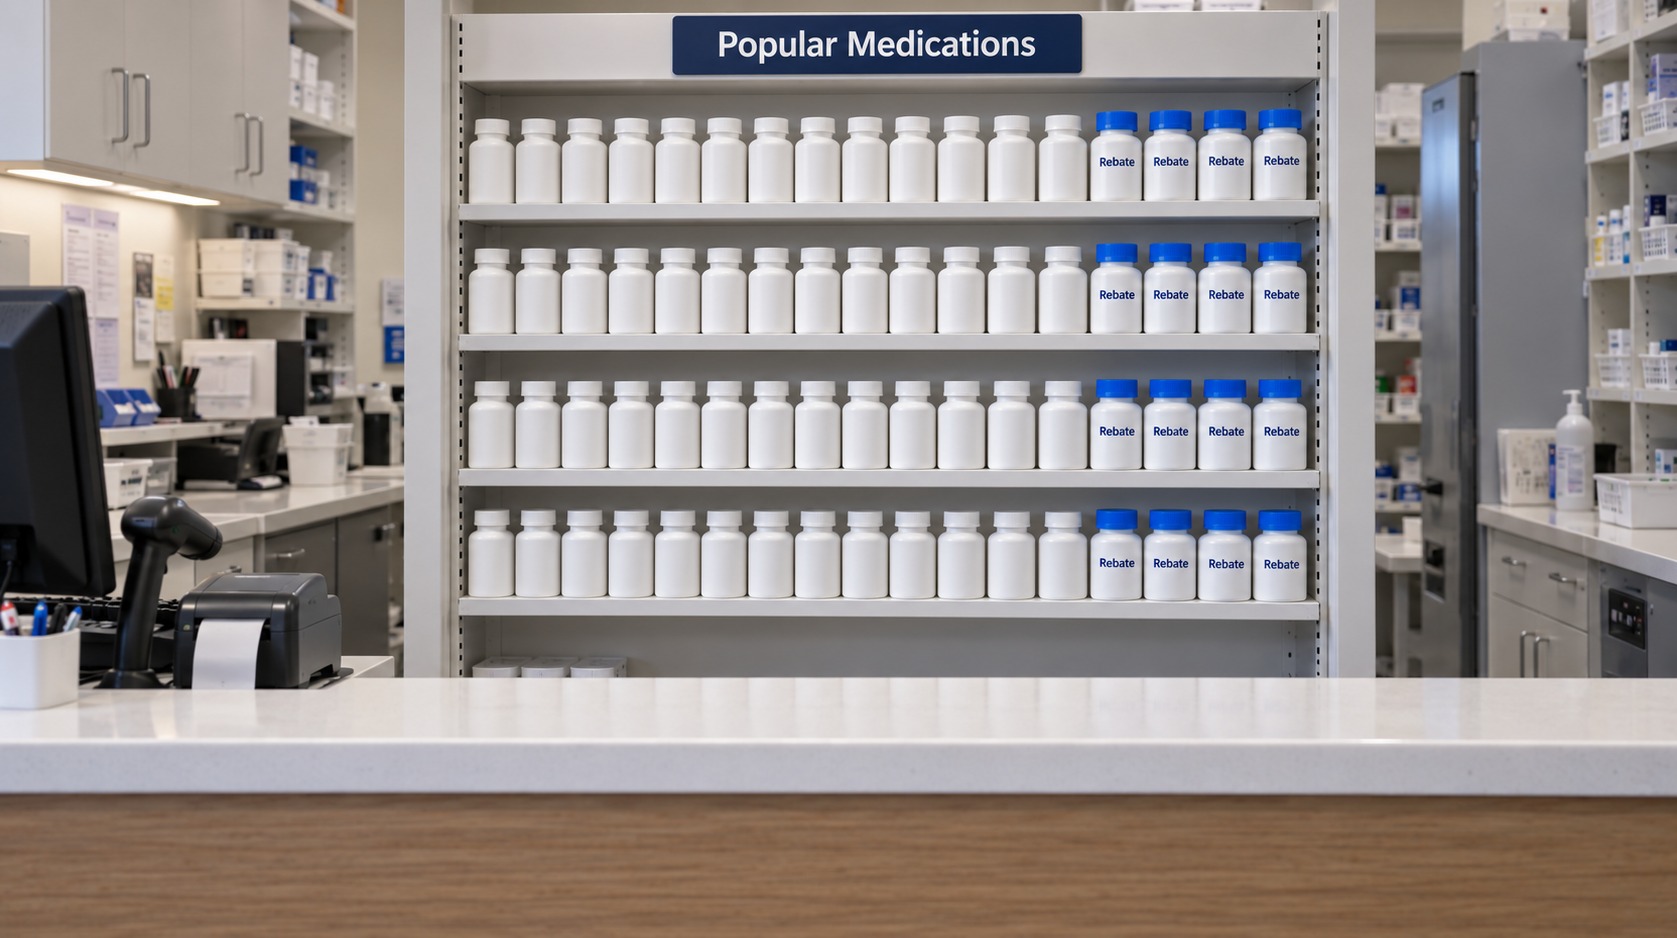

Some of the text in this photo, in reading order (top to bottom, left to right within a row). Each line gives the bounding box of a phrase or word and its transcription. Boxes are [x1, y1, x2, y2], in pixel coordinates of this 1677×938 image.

[718, 30, 1036, 64] Popular Medications
[1099, 156, 1136, 168] Rebate
[1153, 156, 1190, 167] Rebate
[1208, 155, 1245, 167] Rebate
[1263, 154, 1301, 166] Rebate
[1099, 289, 1136, 300] Rebate
[1153, 289, 1190, 300] Rebate
[1208, 289, 1245, 300] Rebate
[1263, 288, 1301, 300] Rebate
[1099, 425, 1136, 437] Rebate
[1153, 426, 1190, 437] Rebate
[1208, 425, 1245, 437] Rebate
[1263, 425, 1301, 437] Rebate
[1099, 557, 1136, 569] Rebate
[1153, 558, 1190, 569] Rebate
[1208, 558, 1245, 570] Rebate
[1263, 558, 1301, 570] Rebate
